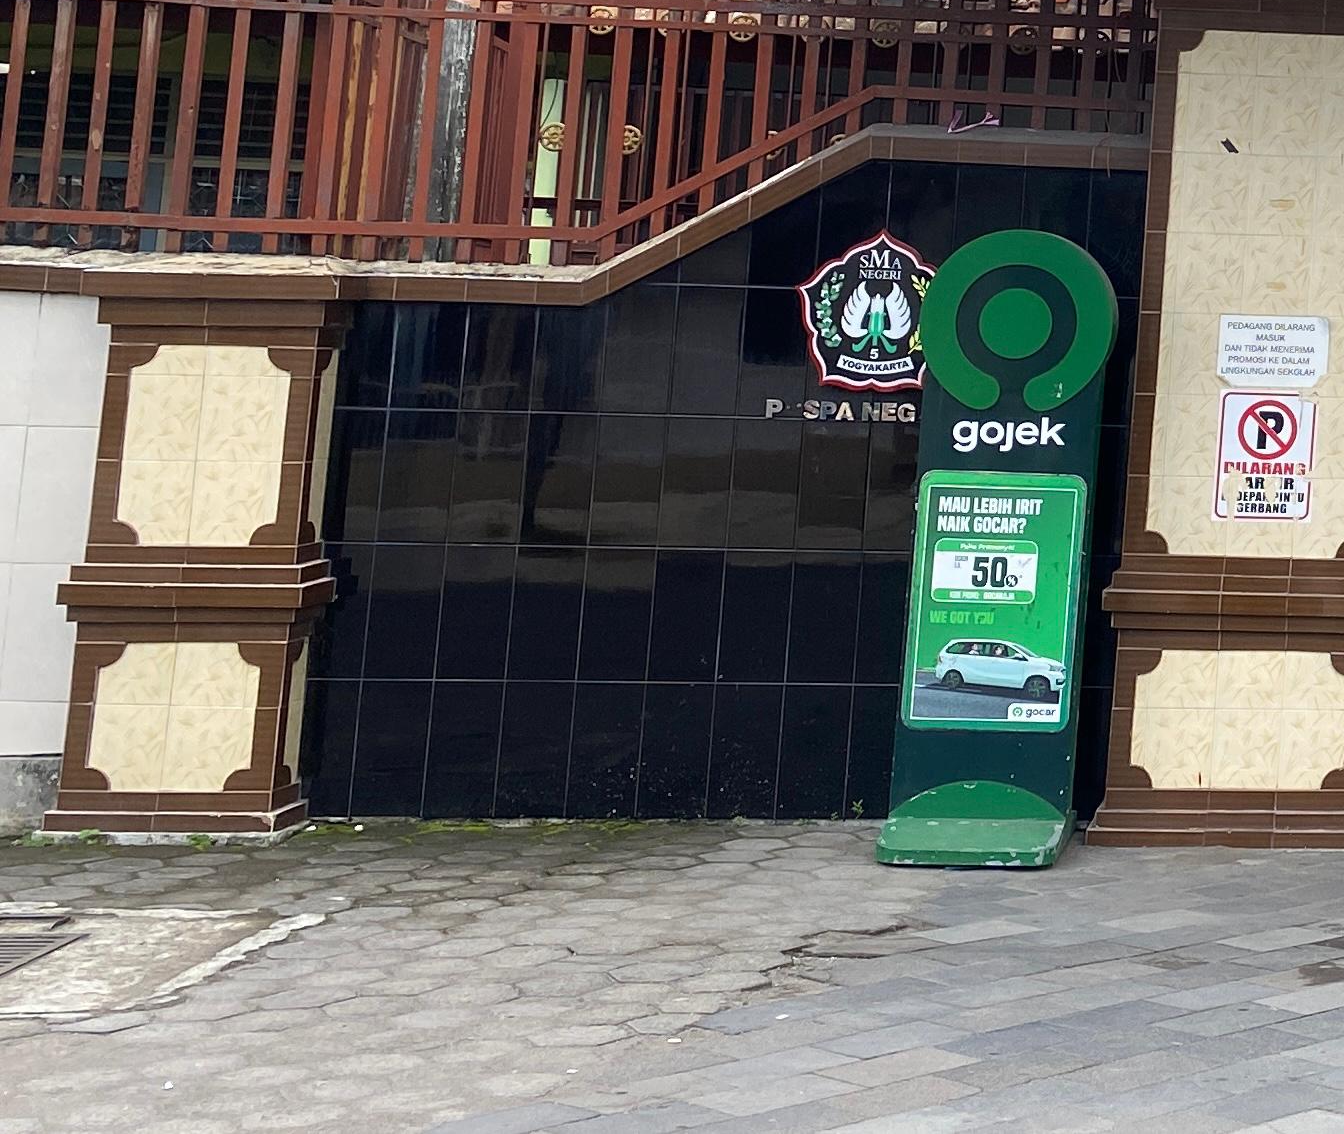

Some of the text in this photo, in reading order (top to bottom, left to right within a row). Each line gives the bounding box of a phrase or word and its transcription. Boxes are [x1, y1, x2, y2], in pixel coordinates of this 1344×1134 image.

[859, 249, 901, 269] SMA
[858, 269, 901, 281] NEGERI
[1227, 321, 1316, 332] PEDAGANG DILARANG
[1256, 334, 1285, 342] MASUK
[869, 348, 879, 360] 5
[1224, 344, 1315, 354] DAN TIDAK MENERIMA
[842, 358, 910, 372] YOGYAKARTA
[1227, 355, 1310, 365] PROMOSI KE DALAM
[1220, 366, 1316, 376] LINGKUNGAN SEKOLAH
[765, 399, 916, 423] PSPA NEG
[952, 417, 1067, 453] gojek
[938, 495, 1044, 516] MAU LEBIH IRIT
[1236, 503, 1288, 514] GERBANG
[937, 515, 1027, 534] NAIK GOCAR?
[929, 610, 995, 625] WE GOT YOU
[1025, 707, 1056, 718] gocar
